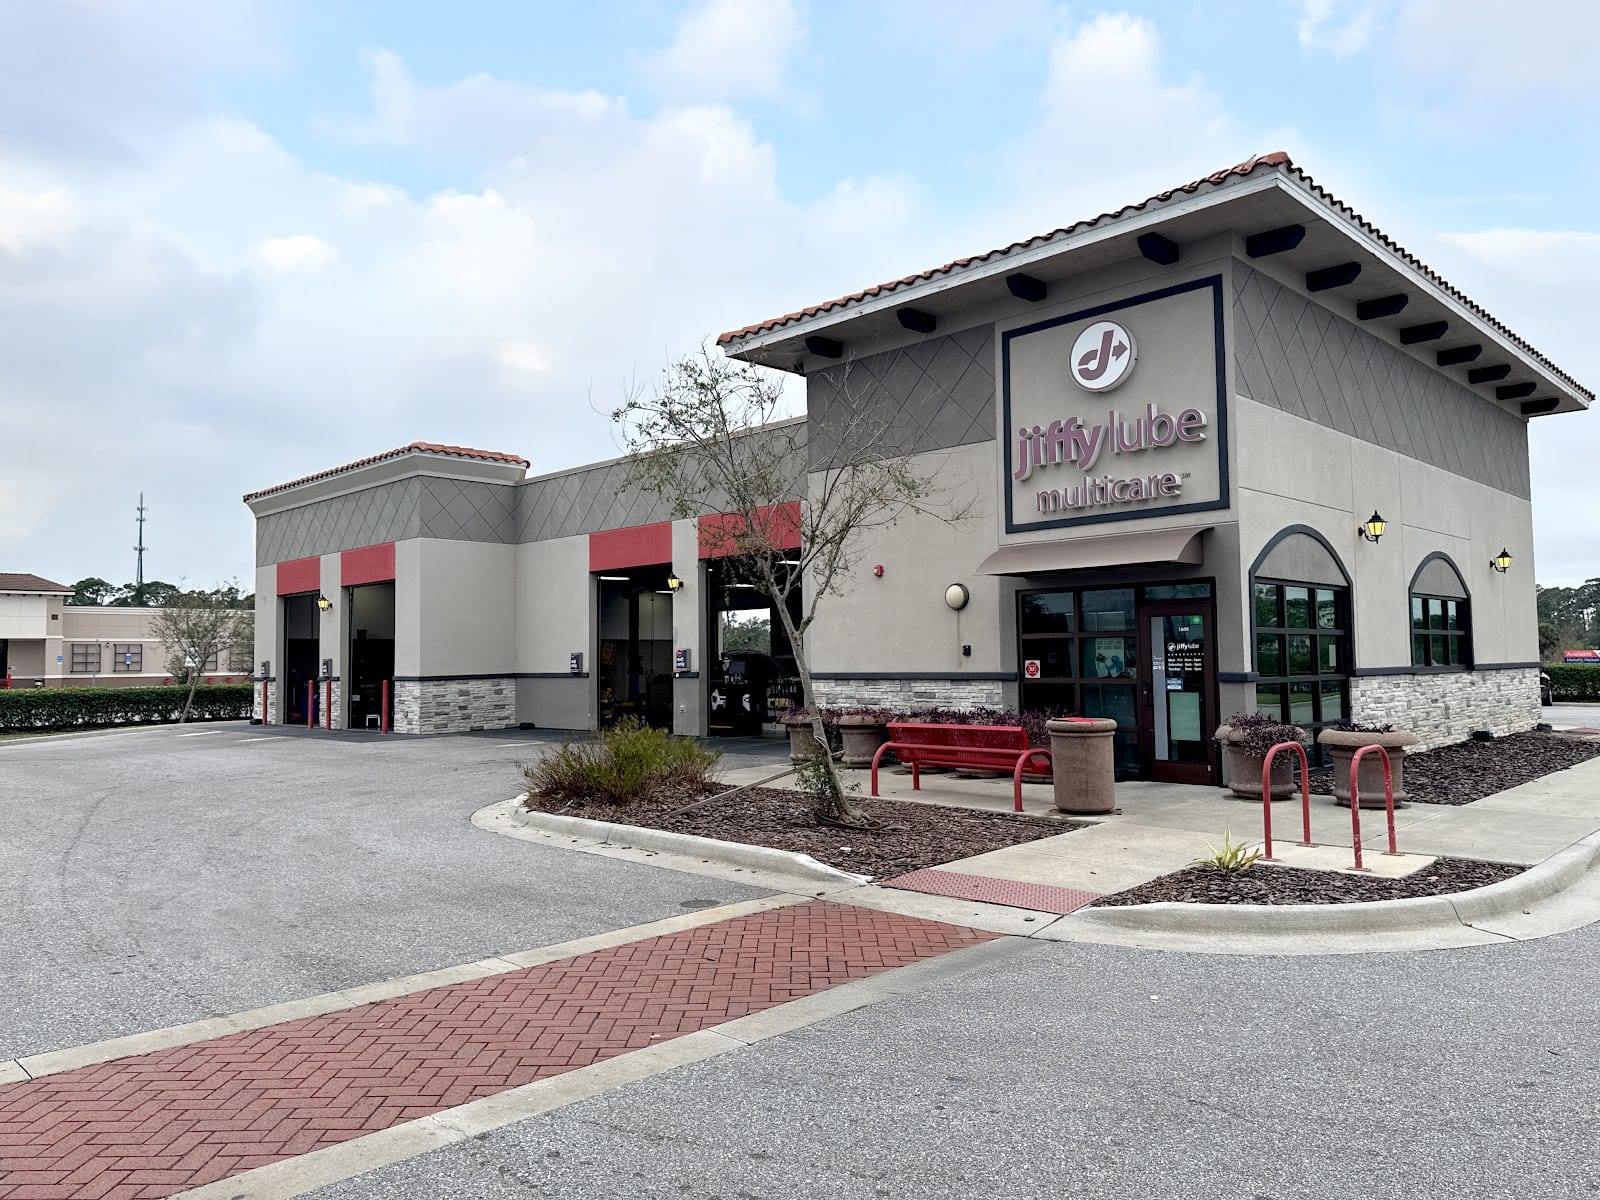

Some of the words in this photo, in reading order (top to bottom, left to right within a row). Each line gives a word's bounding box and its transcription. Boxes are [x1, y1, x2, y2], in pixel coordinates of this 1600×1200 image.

[1014, 416, 1106, 481] jiffy
[1108, 403, 1207, 454] lube
[1036, 473, 1181, 513] multicare
[1176, 642, 1188, 650] jiffy
